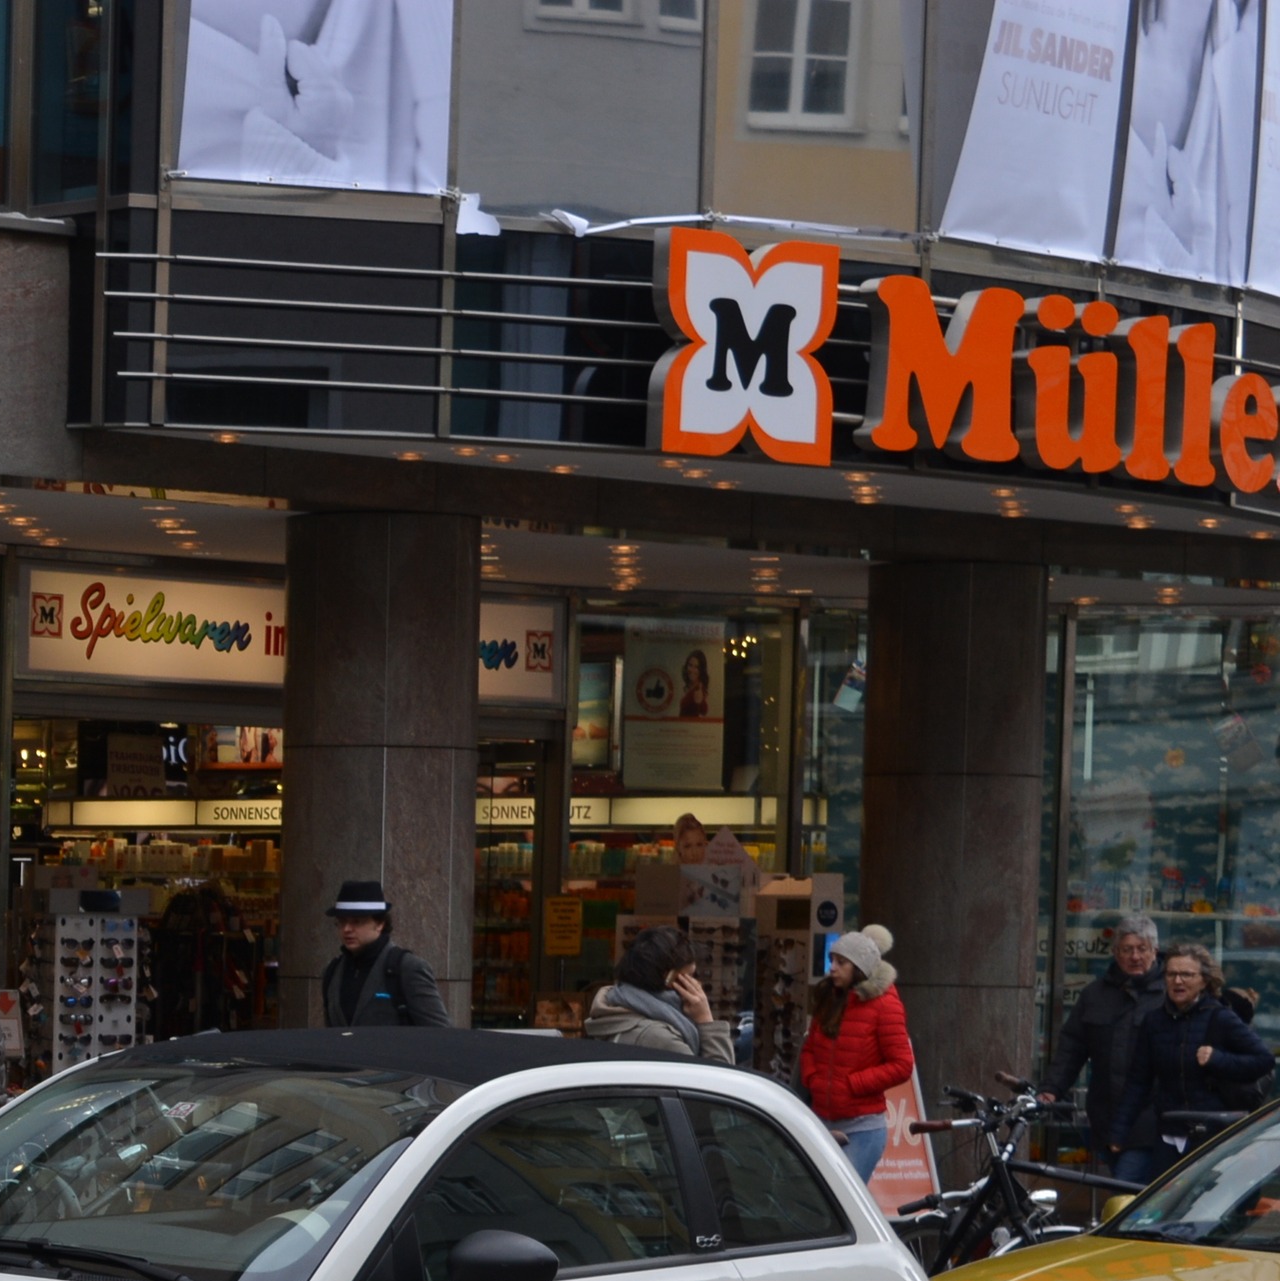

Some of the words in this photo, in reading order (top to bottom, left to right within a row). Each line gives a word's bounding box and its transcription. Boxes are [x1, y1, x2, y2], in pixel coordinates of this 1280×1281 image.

[993, 19, 1025, 60] JIL
[1027, 27, 1115, 83] SANDER
[996, 70, 1099, 127] SUNLIGHT
[705, 296, 797, 399] M
[870, 275, 1280, 495] Mülle
[38, 602, 57, 626] M
[69, 581, 253, 660] Spielwaren
